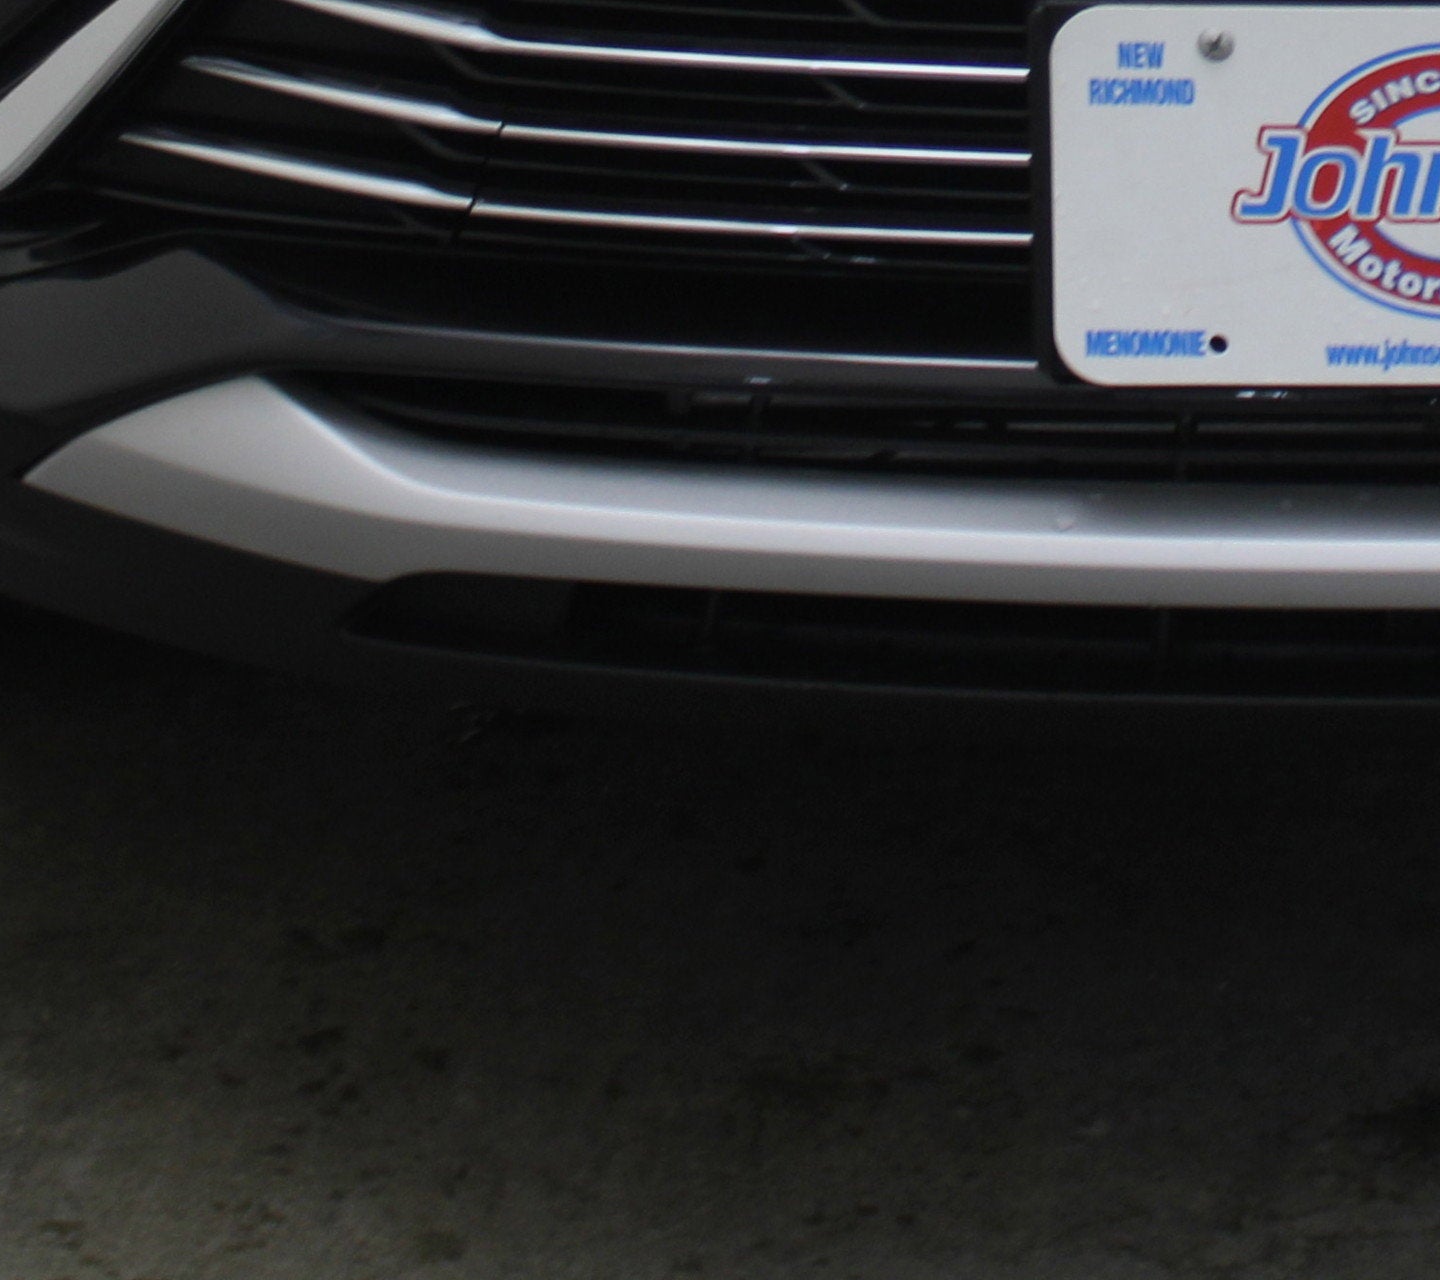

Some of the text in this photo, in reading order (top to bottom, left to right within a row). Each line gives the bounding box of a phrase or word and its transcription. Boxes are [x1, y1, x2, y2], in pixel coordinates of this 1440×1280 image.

[1118, 42, 1165, 69] NEW
[1089, 79, 1195, 105] RICHMOND
[1086, 330, 1206, 356] MENOMONIE
